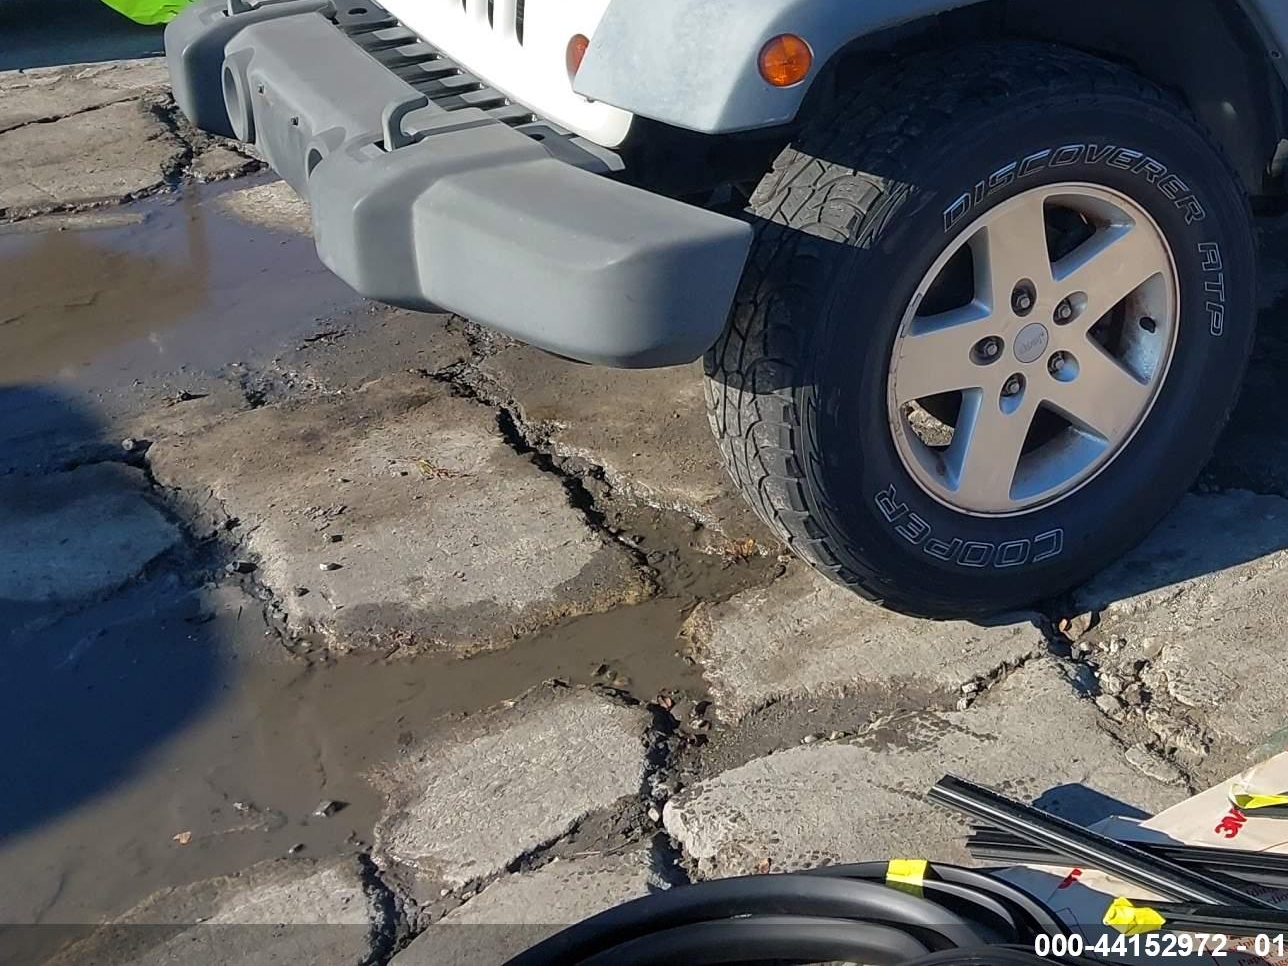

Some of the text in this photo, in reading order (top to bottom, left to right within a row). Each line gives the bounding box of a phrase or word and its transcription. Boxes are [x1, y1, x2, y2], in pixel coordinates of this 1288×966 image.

[943, 144, 1227, 337] DISCOVERER ATP
[874, 483, 1064, 568] COOPER
